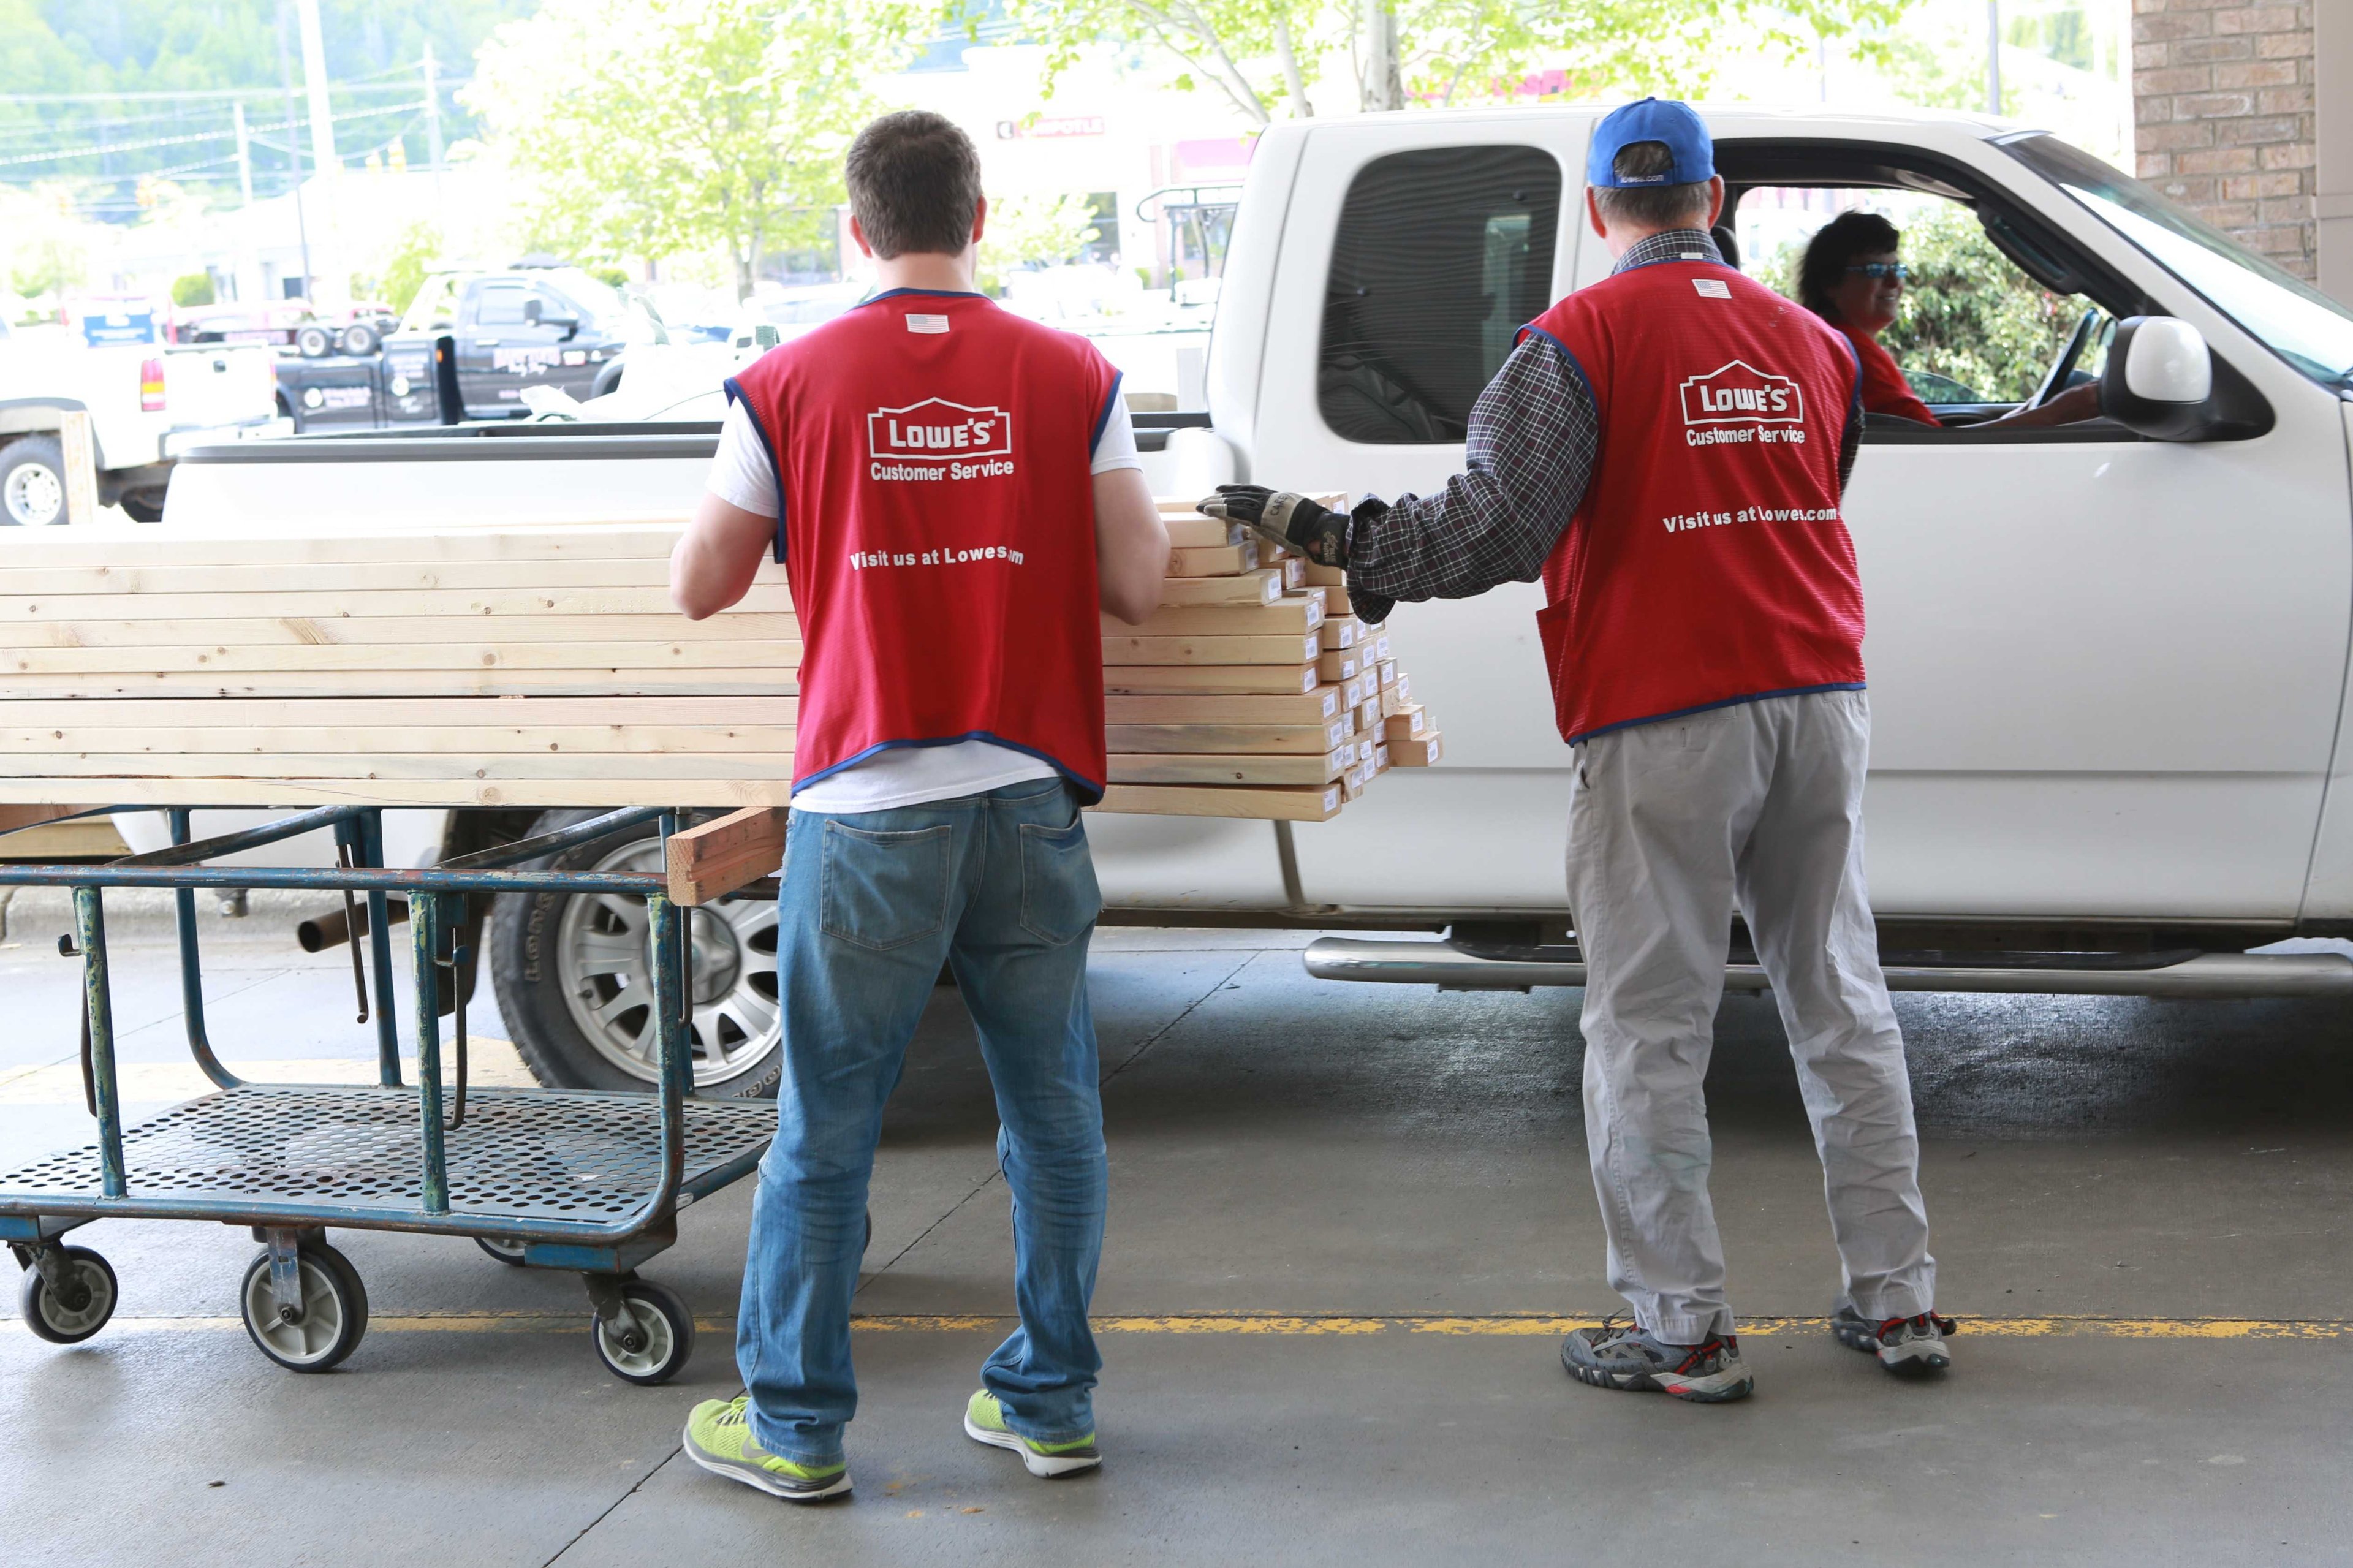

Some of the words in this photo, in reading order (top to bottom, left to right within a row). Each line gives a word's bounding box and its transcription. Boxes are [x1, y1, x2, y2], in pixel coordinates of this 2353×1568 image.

[1686, 426, 1756, 447] Customer
[1758, 425, 1805, 444] Service
[871, 462, 946, 481] Customer
[950, 458, 1014, 480] Service
[1662, 511, 1711, 533] Visit
[1713, 513, 1732, 525] us
[1737, 506, 1757, 523] at
[849, 551, 889, 571] Visit
[893, 553, 915, 566] us
[922, 549, 939, 564] at
